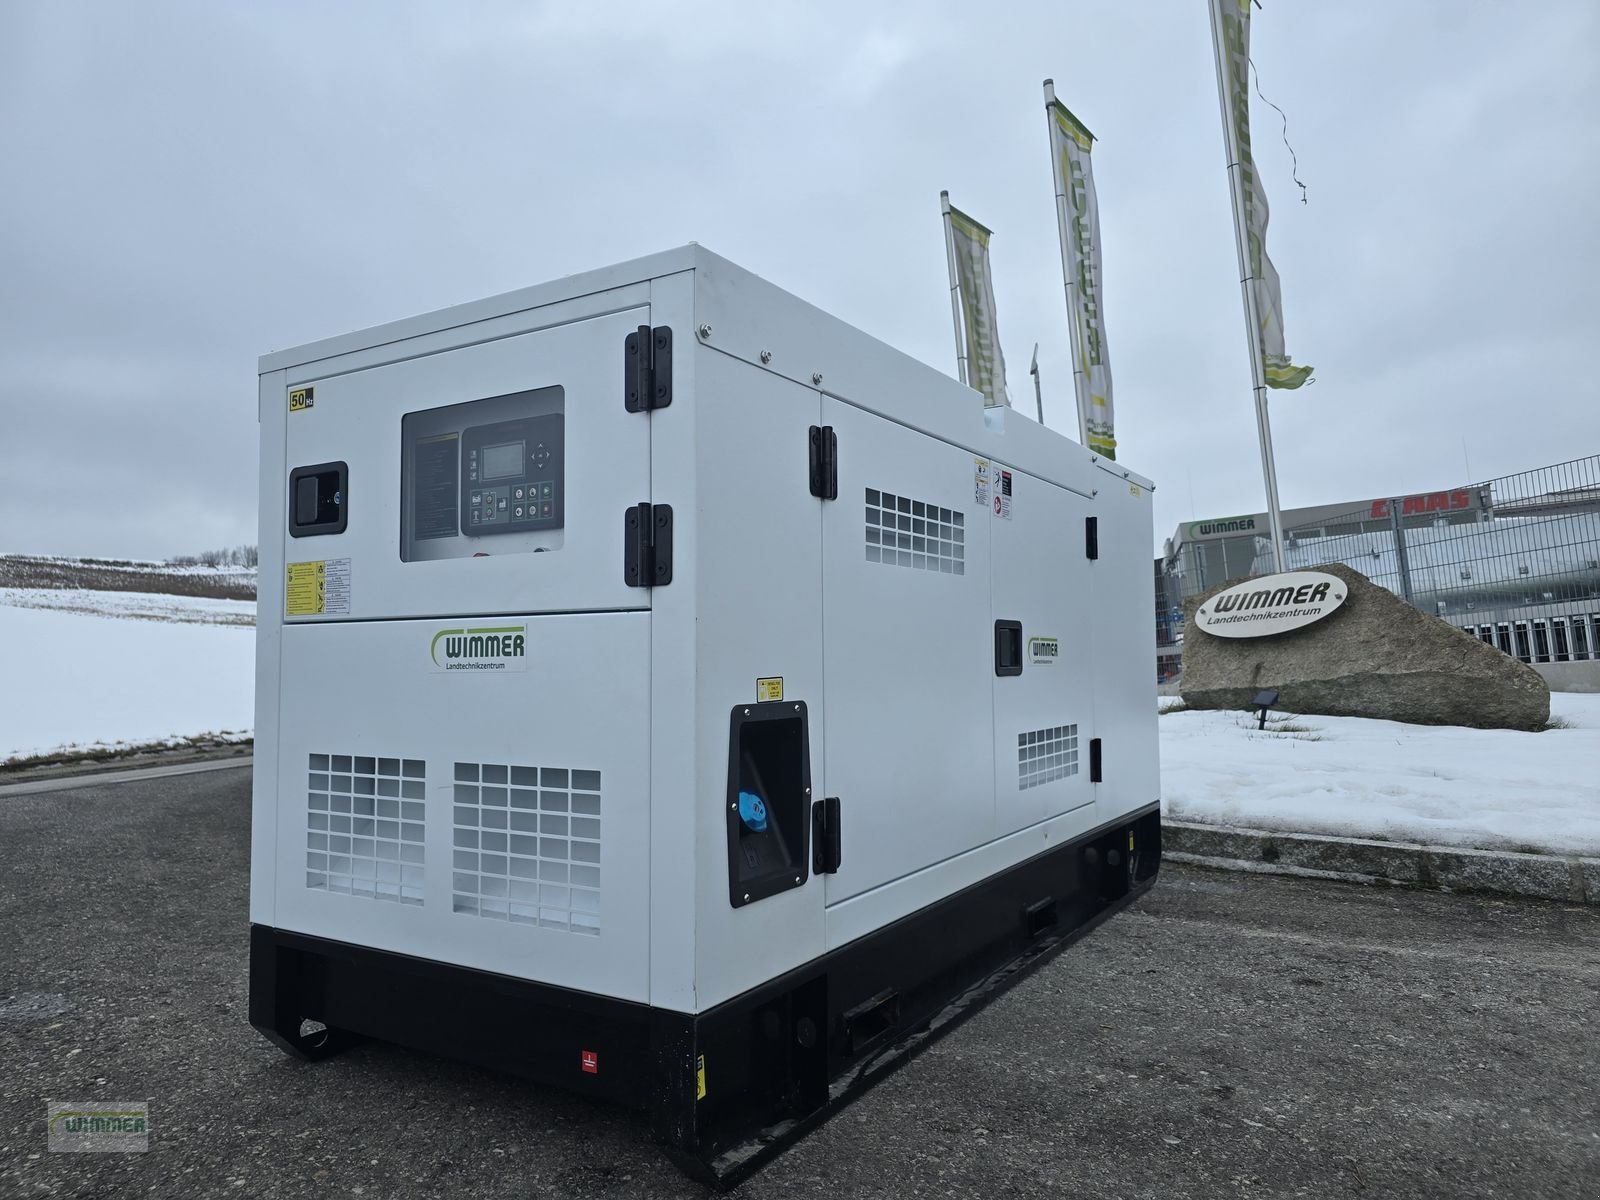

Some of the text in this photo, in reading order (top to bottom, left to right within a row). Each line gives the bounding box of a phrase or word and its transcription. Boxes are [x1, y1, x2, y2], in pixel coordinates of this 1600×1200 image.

[292, 393, 305, 407] 50
[1371, 490, 1470, 518] CAAS
[1200, 519, 1255, 535] WIMMER
[1213, 582, 1331, 613] WIMMER
[1207, 607, 1321, 625] Landtechnikzentrum
[446, 634, 525, 658] WIMMER
[1032, 642, 1058, 657] WIMMER
[446, 662, 505, 671] Landtechnikzentrum
